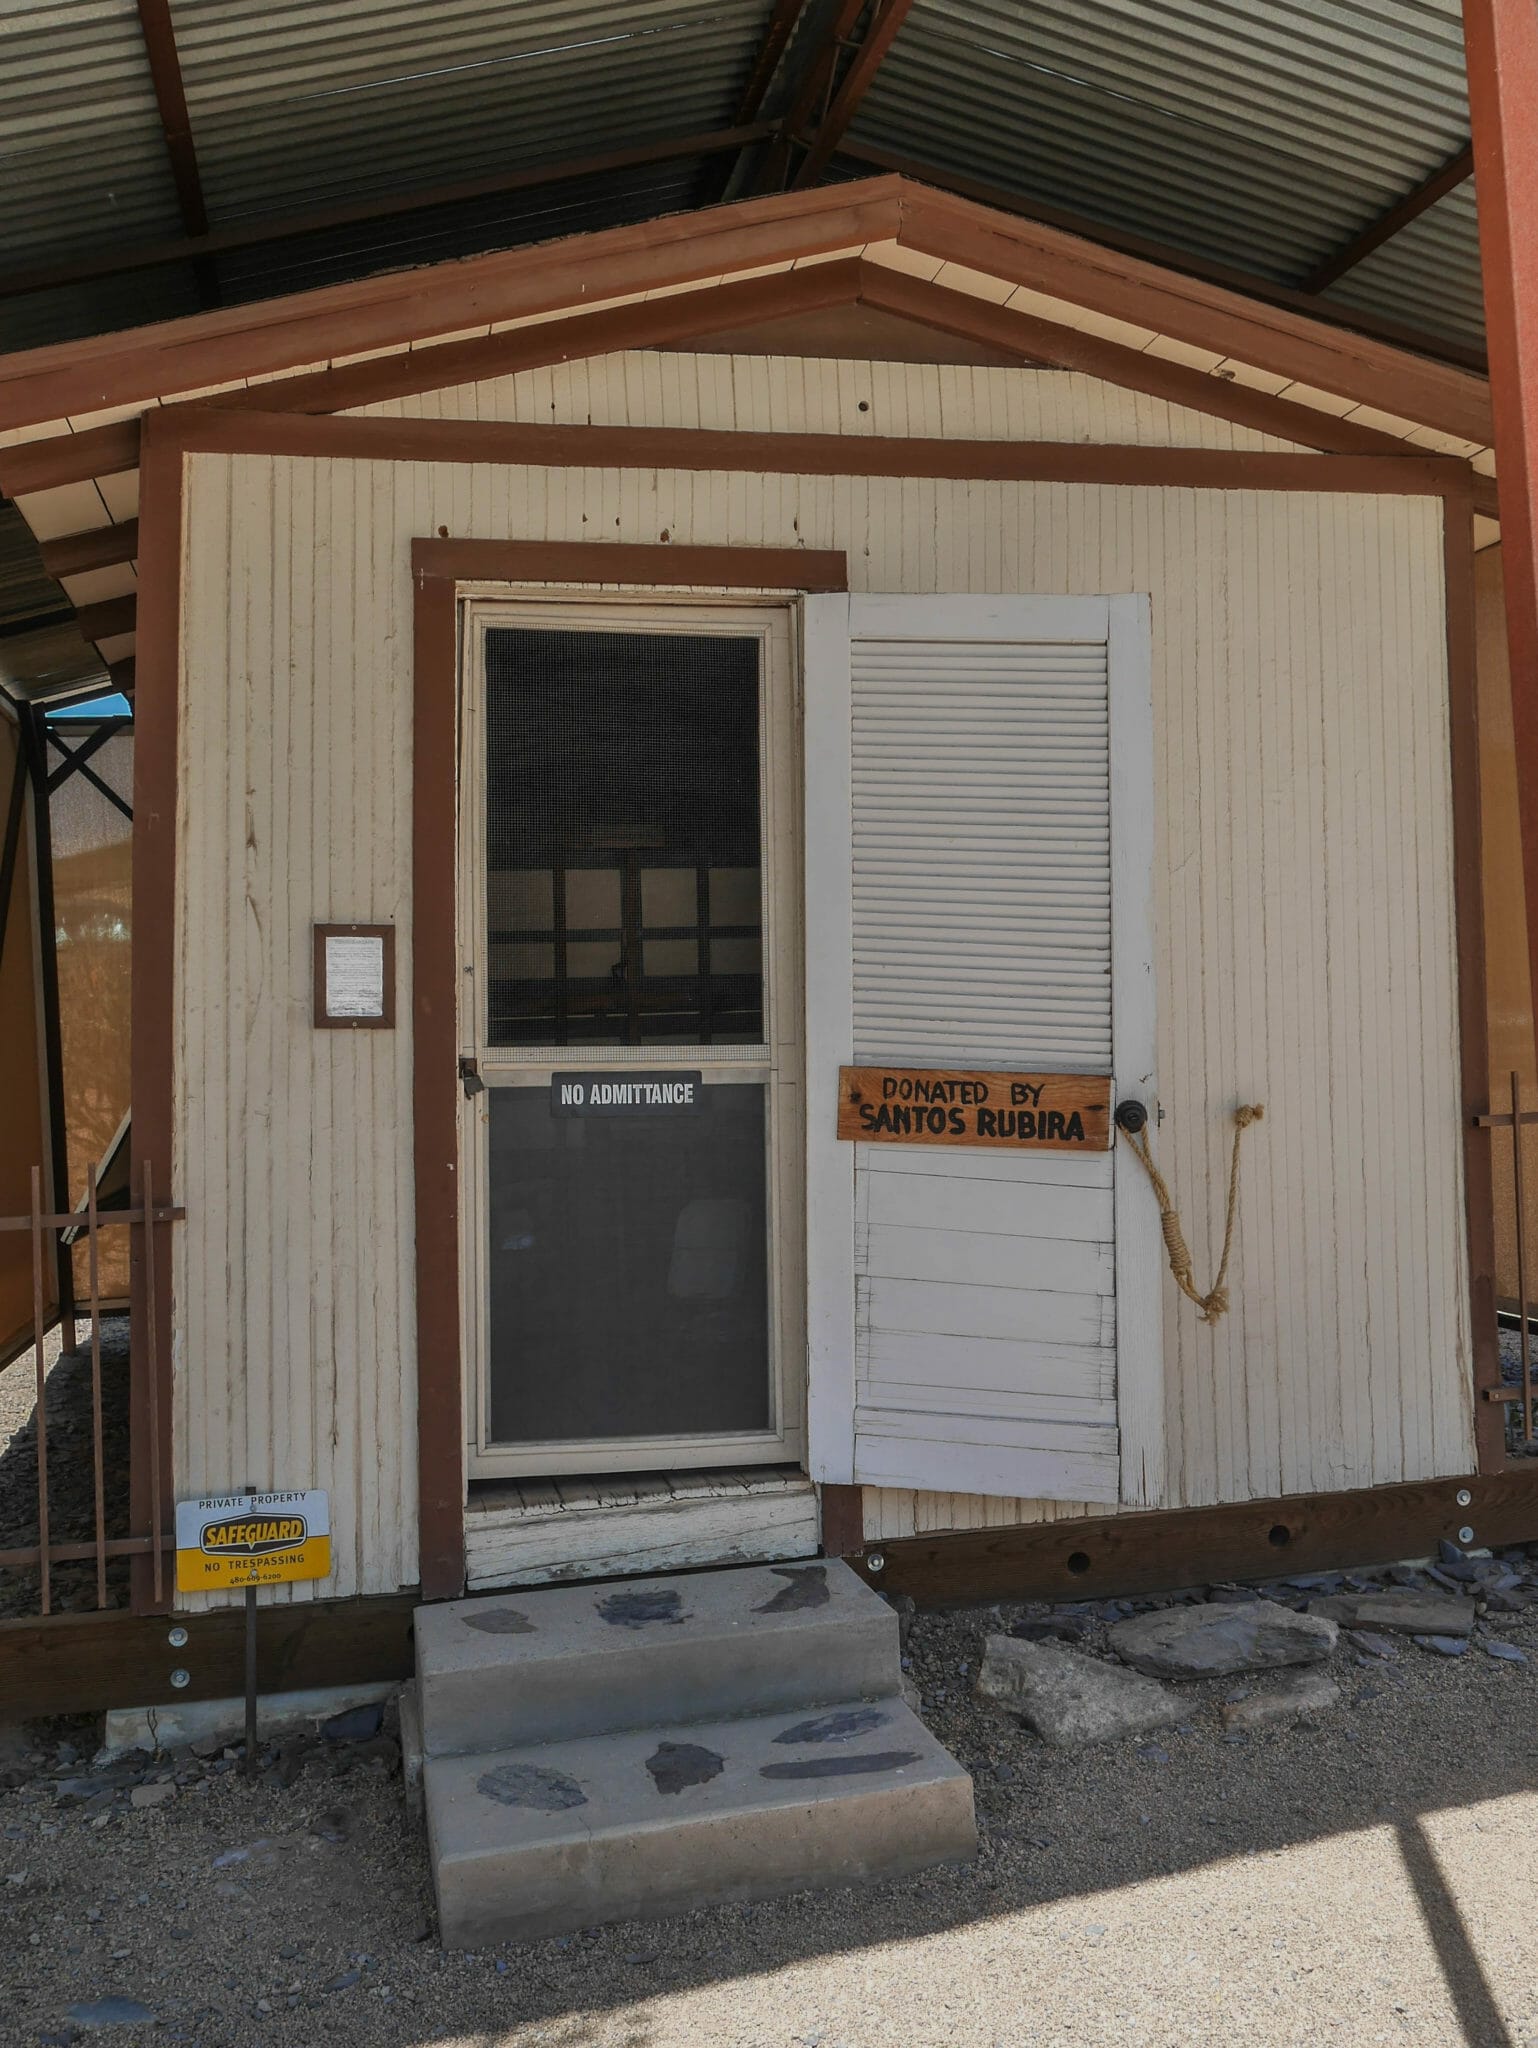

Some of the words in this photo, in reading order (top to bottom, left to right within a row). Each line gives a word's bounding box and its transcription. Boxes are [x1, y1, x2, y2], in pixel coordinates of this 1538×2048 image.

[561, 1084, 584, 1105] NO
[590, 1083, 694, 1104] ADMITTANCE
[882, 1077, 989, 1104] DONATED
[1010, 1083, 1046, 1107] BY
[859, 1103, 966, 1135] SANTOS
[977, 1108, 1086, 1141] RUBIRA
[199, 1497, 243, 1509] PRIVATE
[251, 1492, 307, 1505] PROPERTY
[205, 1520, 303, 1546] SAFEGUARD
[204, 1562, 221, 1572] NO
[228, 1554, 305, 1570] TRESPASSING
